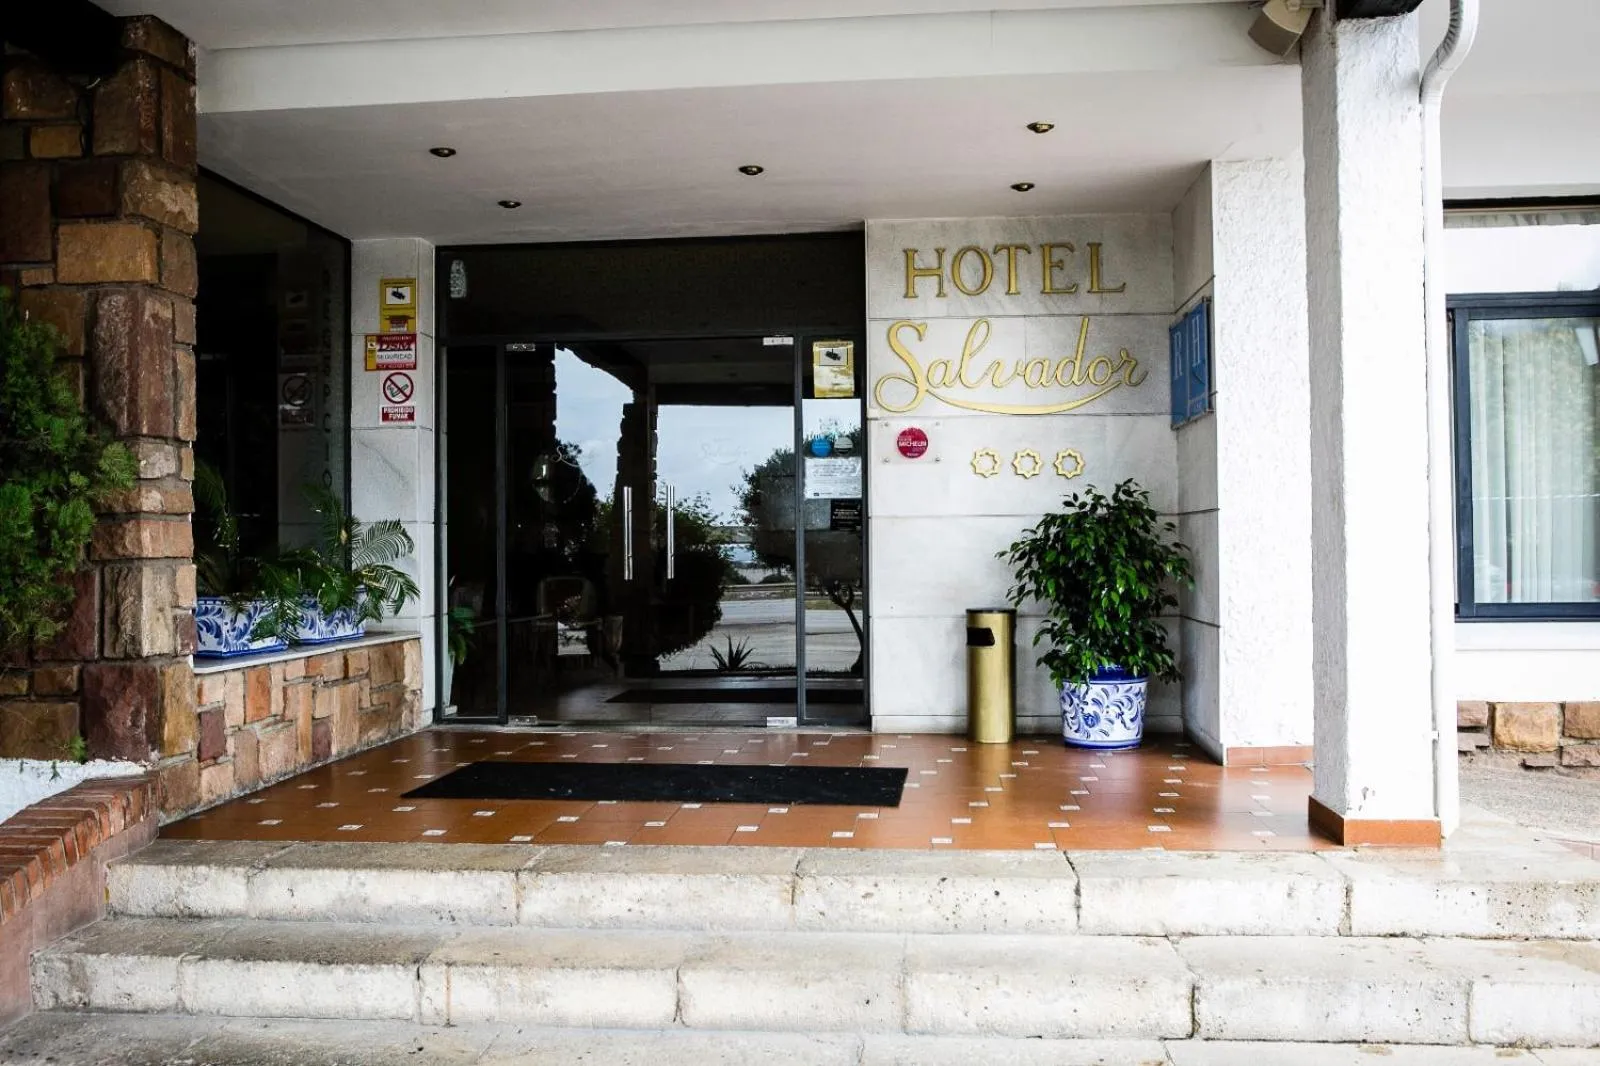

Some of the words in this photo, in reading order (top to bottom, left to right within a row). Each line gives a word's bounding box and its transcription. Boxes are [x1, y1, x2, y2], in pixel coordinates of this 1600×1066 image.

[902, 242, 1127, 298] HOTEL
[875, 316, 1149, 415] Salvador
[1174, 331, 1183, 379] R
